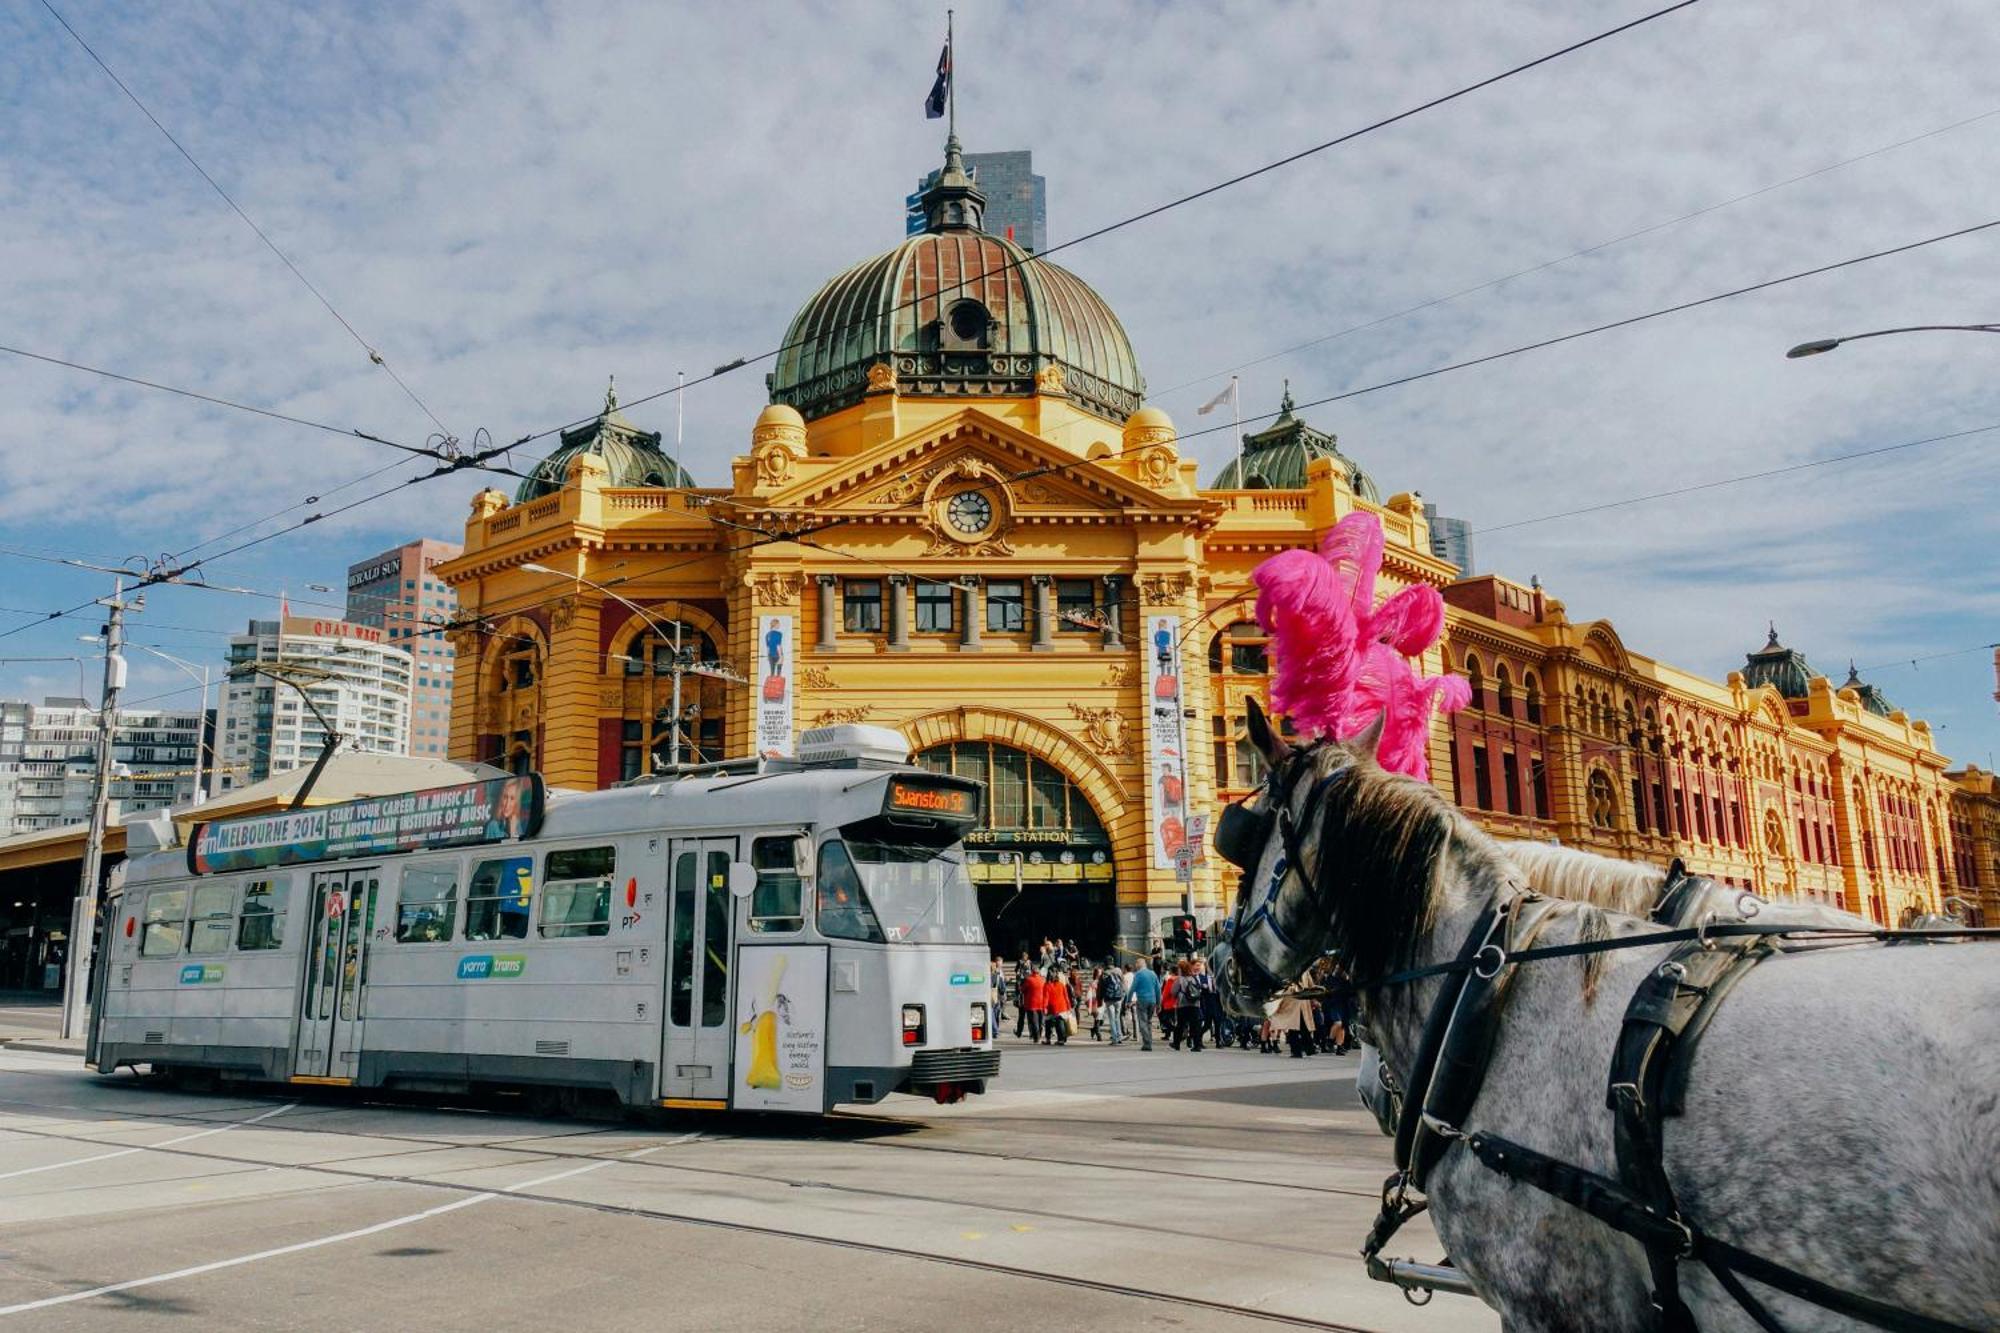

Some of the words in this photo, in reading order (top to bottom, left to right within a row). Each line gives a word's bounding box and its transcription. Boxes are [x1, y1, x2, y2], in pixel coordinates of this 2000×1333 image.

[348, 567, 380, 589] HERALD
[382, 559, 400, 577] SUN
[314, 622, 348, 637] QUAY
[355, 626, 381, 642] WEST
[329, 804, 355, 823] START
[357, 802, 379, 820] YOUR
[382, 797, 415, 817] CAREER
[418, 795, 429, 811] IN
[432, 790, 462, 809] MUSIC
[464, 788, 477, 805] AT
[895, 784, 948, 809] Swanston
[219, 819, 289, 848] MELBOURNE
[293, 814, 325, 840] 2014
[328, 824, 343, 840] THE
[346, 816, 398, 838] AUSTRALIAN
[399, 812, 442, 832] INSTITUTE
[445, 809, 457, 825] OF
[459, 804, 491, 823] MUSIC
[963, 832, 999, 843] REET
[1013, 831, 1070, 842] STATION
